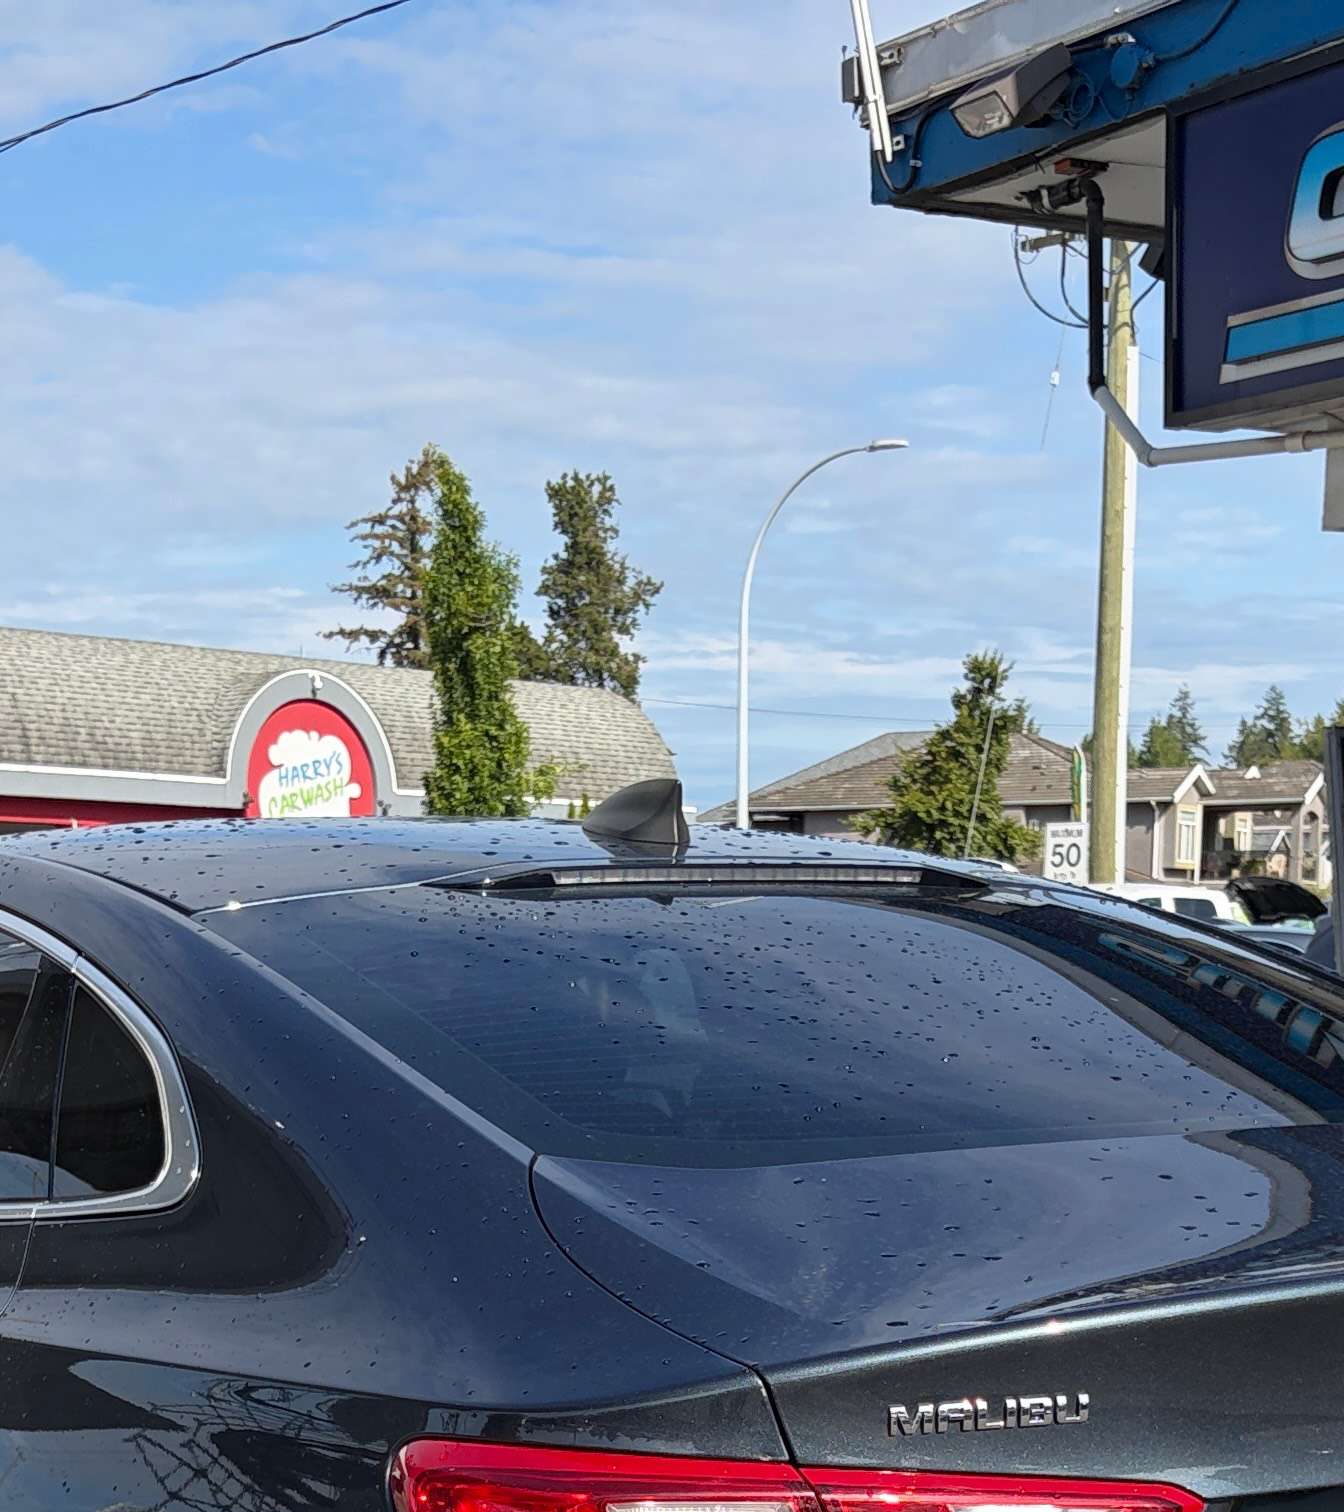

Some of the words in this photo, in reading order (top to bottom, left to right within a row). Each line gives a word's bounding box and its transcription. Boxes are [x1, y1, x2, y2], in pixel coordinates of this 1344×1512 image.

[278, 750, 343, 787] HARRY'S
[1051, 843, 1081, 868] 50
[887, 1391, 1090, 1438] MALIBU
